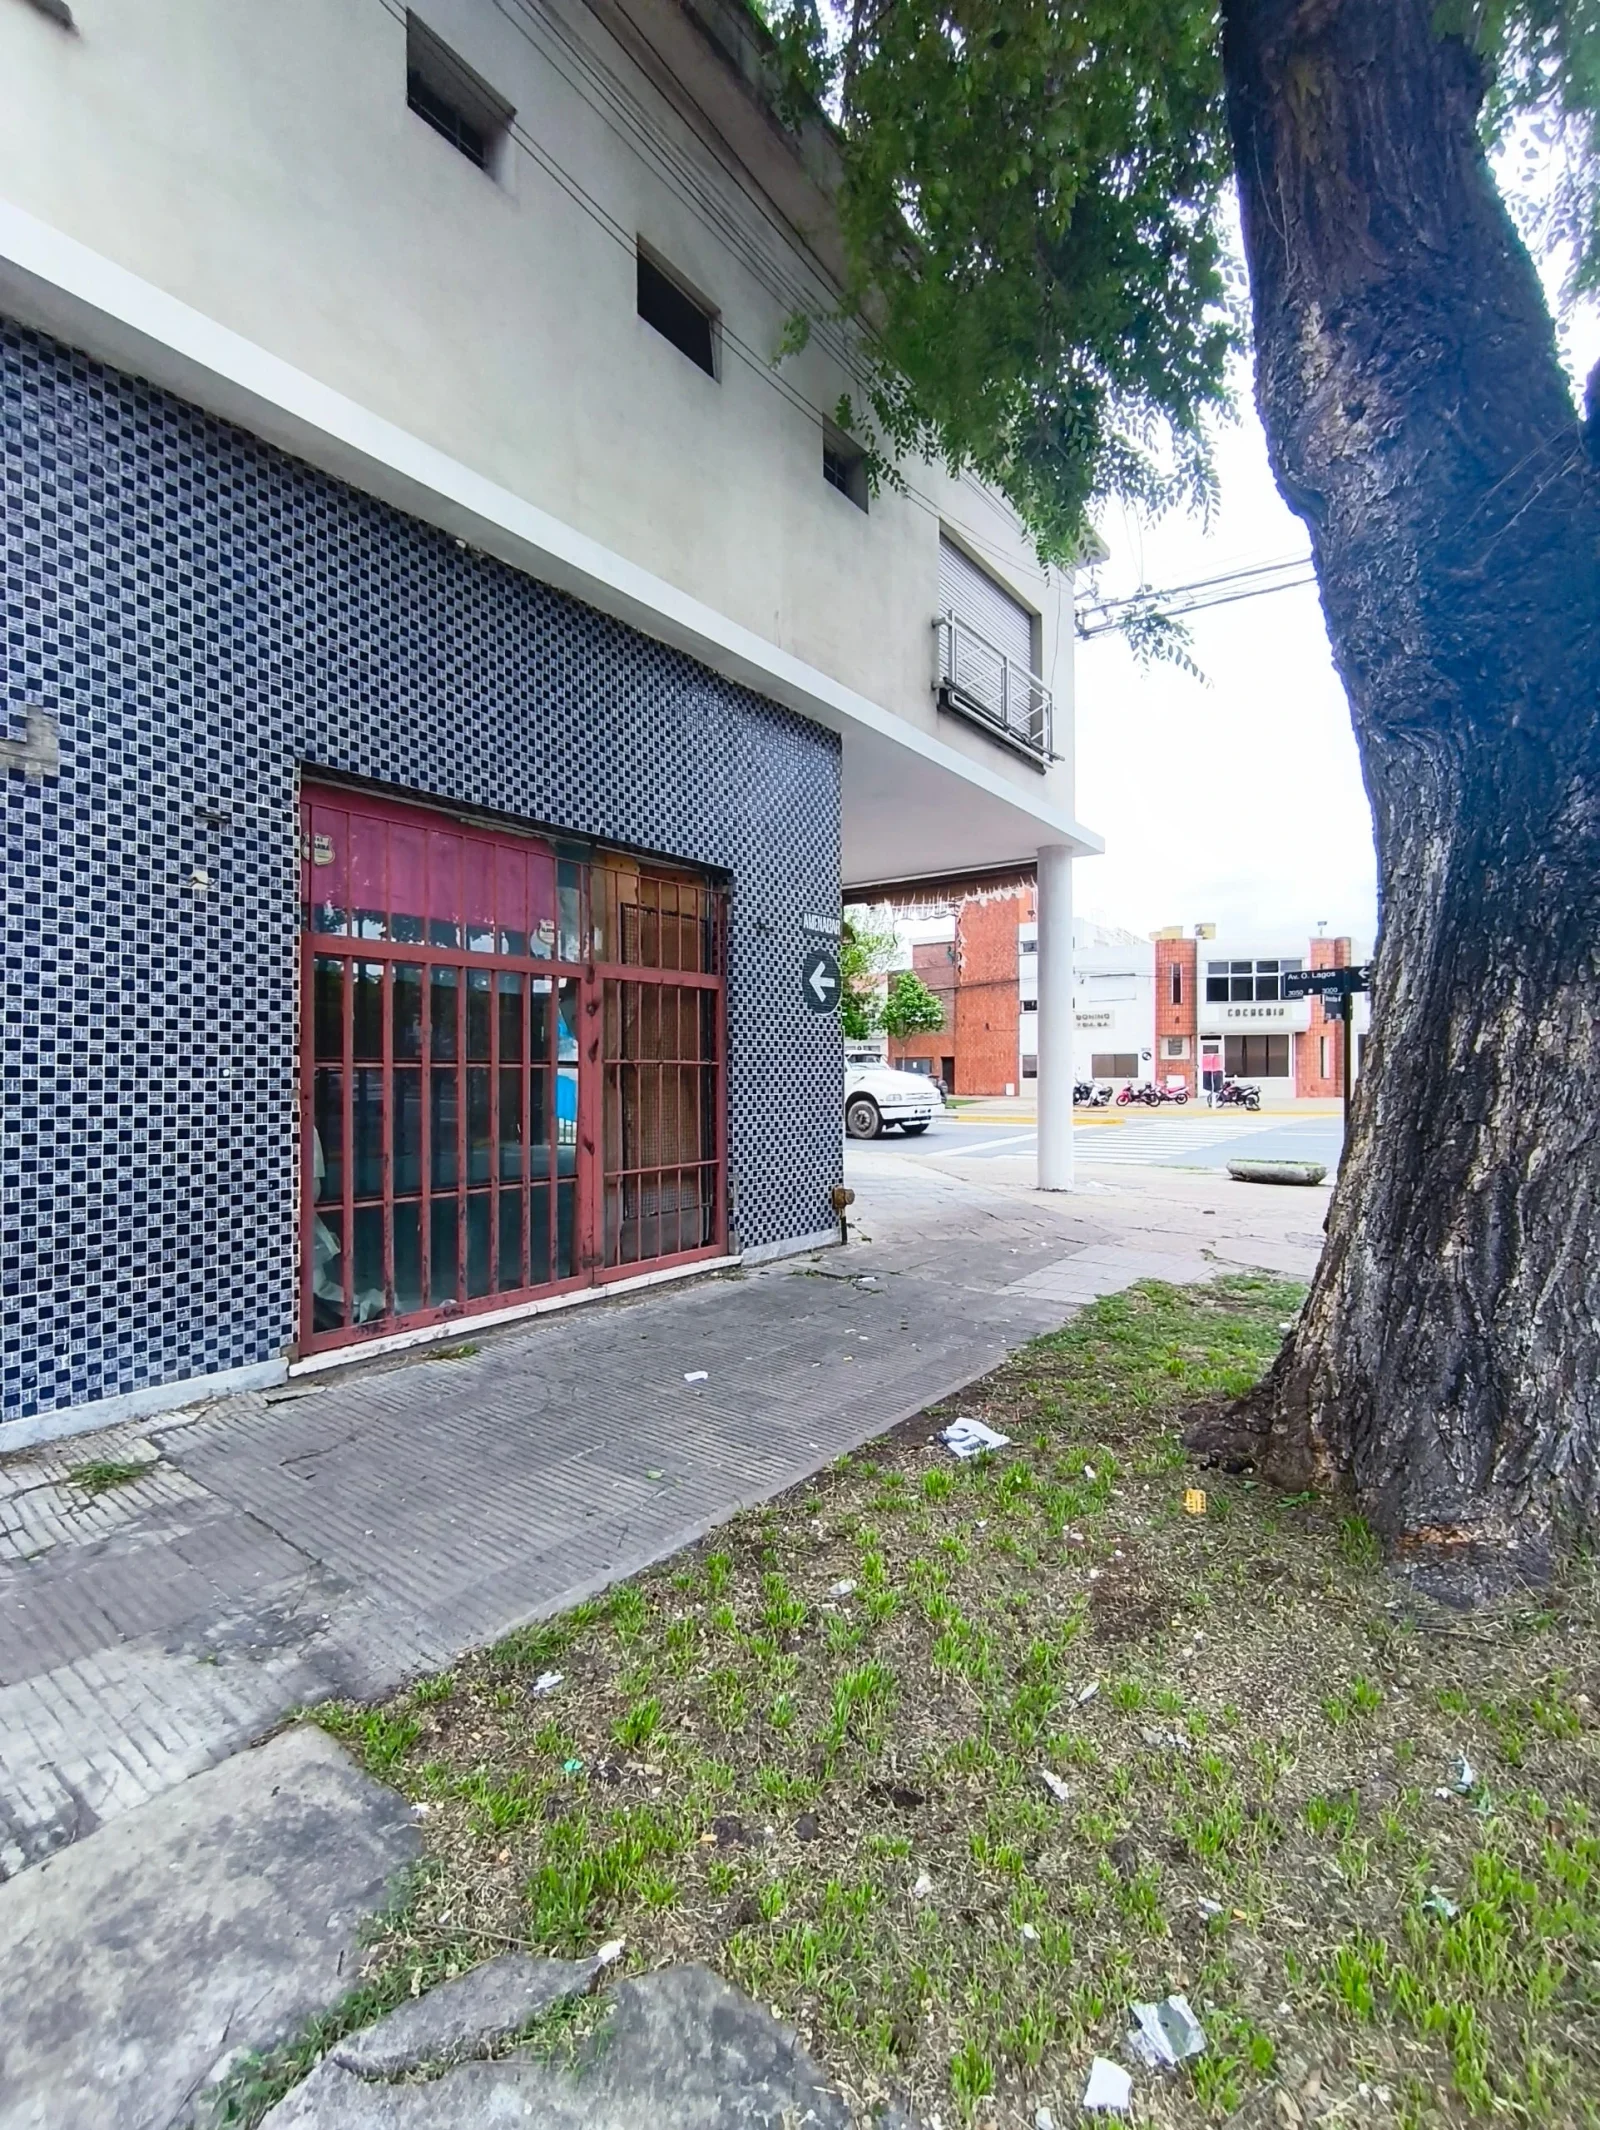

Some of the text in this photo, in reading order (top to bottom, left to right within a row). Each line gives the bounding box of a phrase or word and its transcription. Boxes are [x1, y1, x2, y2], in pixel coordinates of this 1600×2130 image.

[803, 912, 841, 935] AMENABAR
[1287, 973, 1300, 981] Av.
[1311, 970, 1336, 980] Lagos
